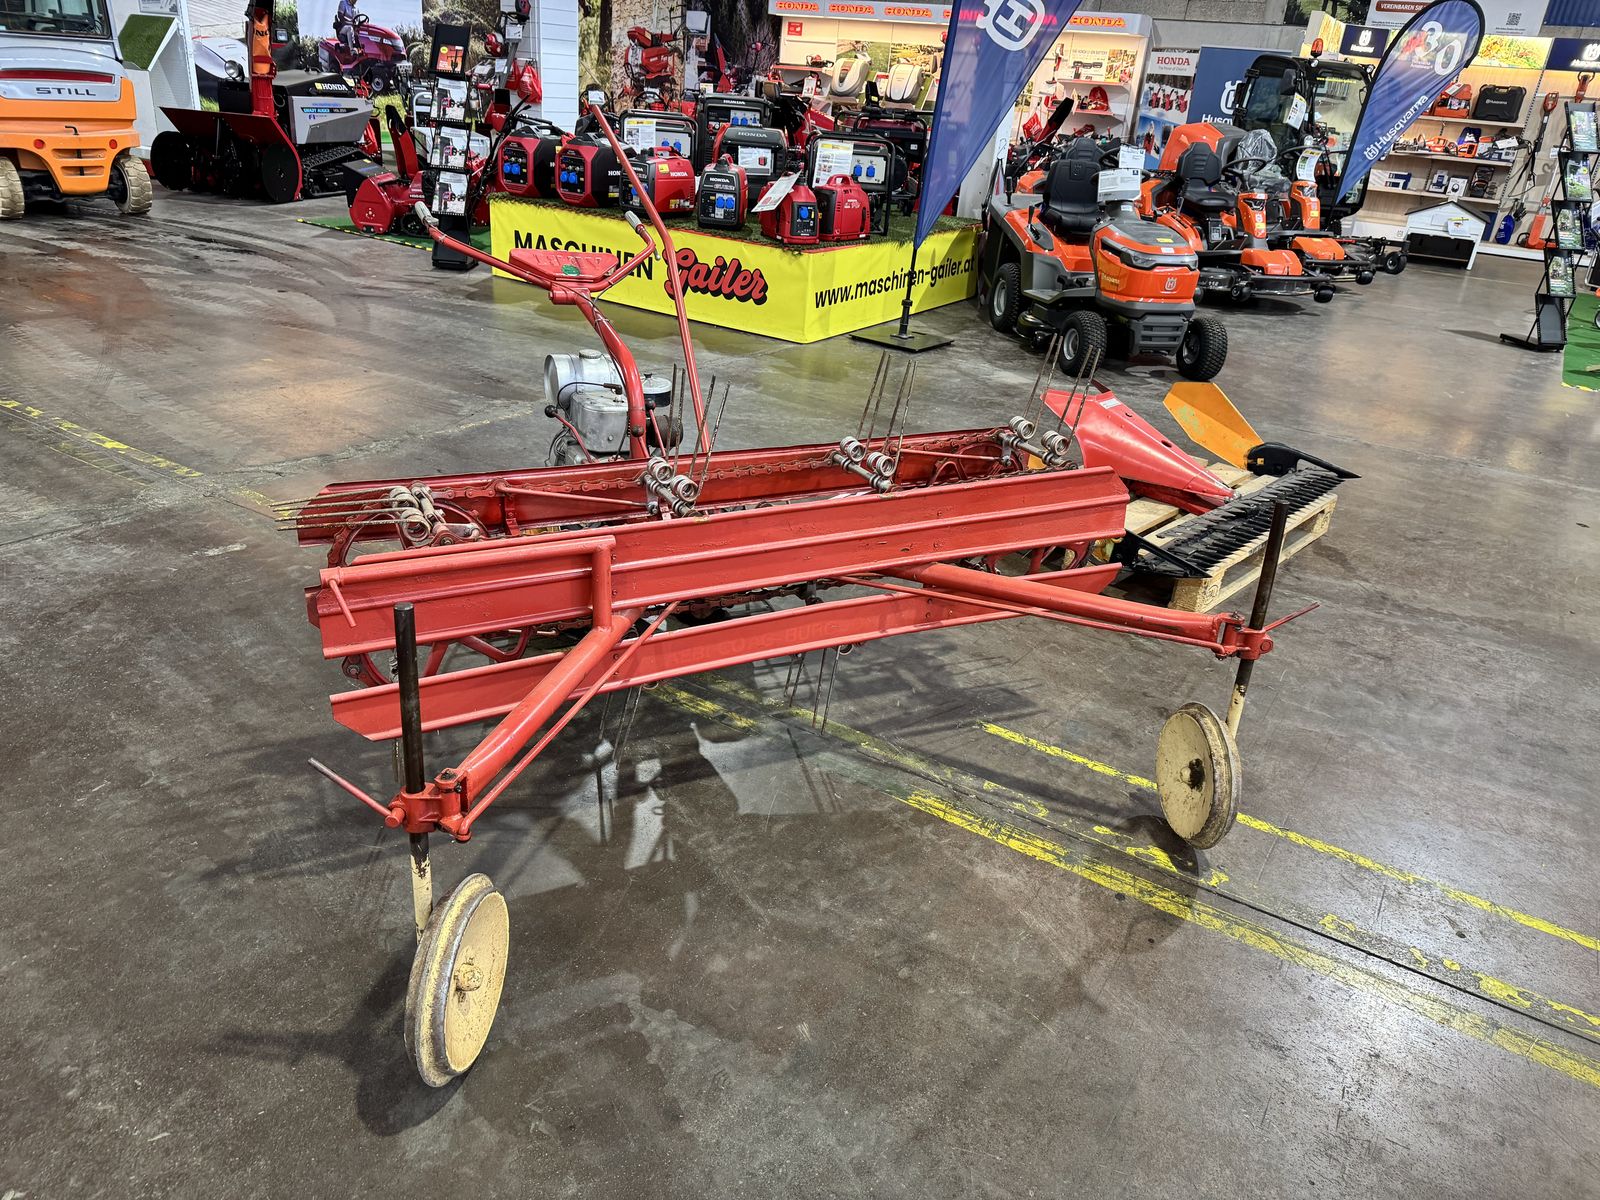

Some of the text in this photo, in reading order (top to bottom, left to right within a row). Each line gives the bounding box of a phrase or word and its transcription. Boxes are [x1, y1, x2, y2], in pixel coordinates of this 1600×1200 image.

[776, 1, 819, 12] HONDA
[829, 4, 874, 15] HONDA
[884, 7, 932, 18] HONDA
[1070, 16, 1126, 27] HONDA
[1156, 56, 1190, 66] HONDA
[36, 87, 97, 97] STILL
[321, 83, 348, 91] HONDA
[1375, 94, 1429, 151] Husqvarna
[738, 130, 768, 138] HONDA
[514, 229, 653, 281] MASCNEN
[662, 247, 768, 306] Gailer
